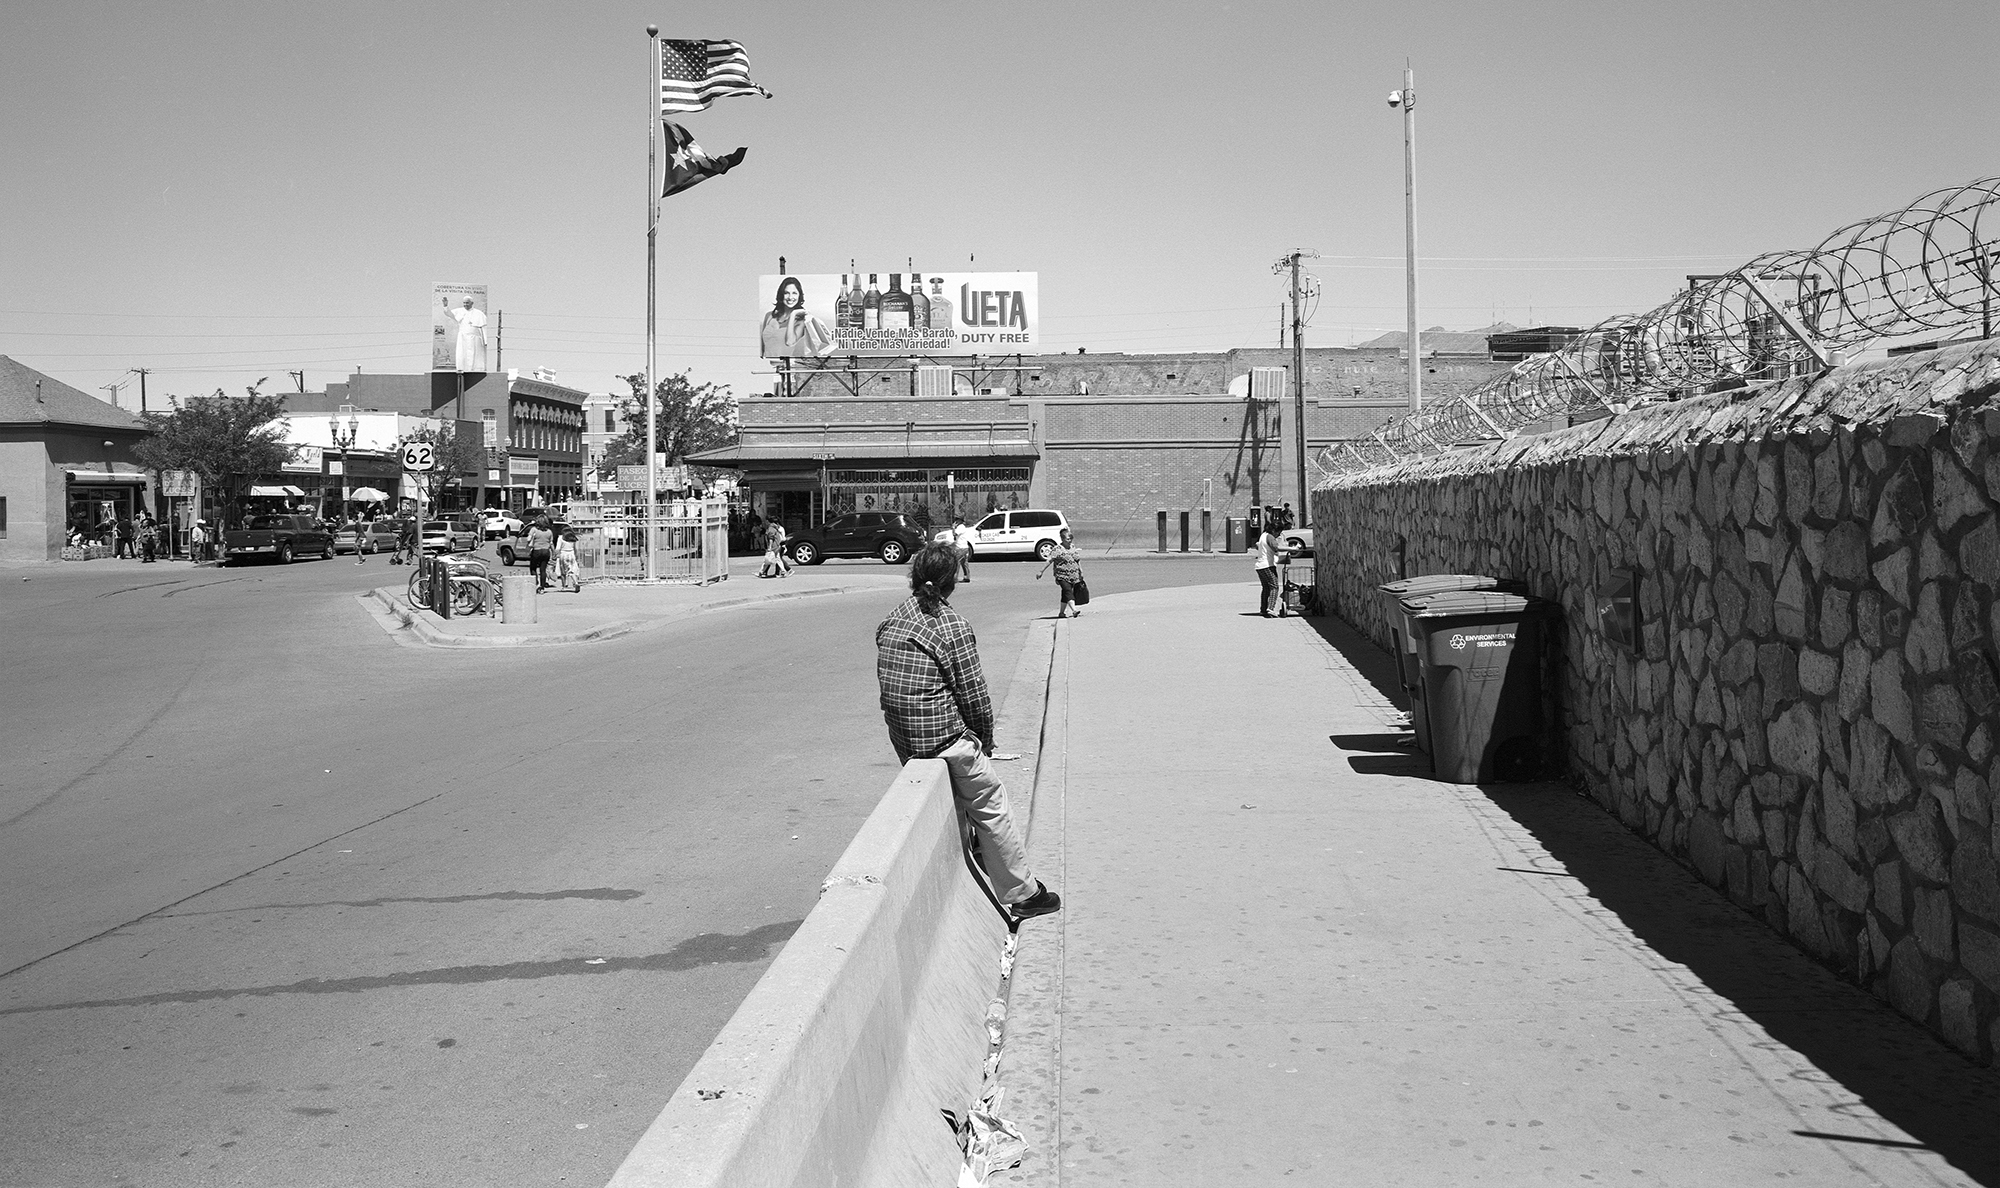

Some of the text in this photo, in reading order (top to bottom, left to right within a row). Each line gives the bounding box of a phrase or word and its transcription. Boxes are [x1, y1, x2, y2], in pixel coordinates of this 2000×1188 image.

[961, 282, 1028, 332] UETA
[831, 328, 863, 341] ¡Nadie
[865, 328, 896, 339] Vende
[922, 327, 958, 340] Barato,
[961, 333, 1030, 343] DUTY FREE
[838, 339, 849, 349] Ni
[851, 338, 878, 349] Tiene
[903, 338, 951, 349] Variedad!
[406, 448, 431, 465] 62
[619, 481, 648, 489] LUCES
[1465, 633, 1516, 641] ENVIRONMENTAL
